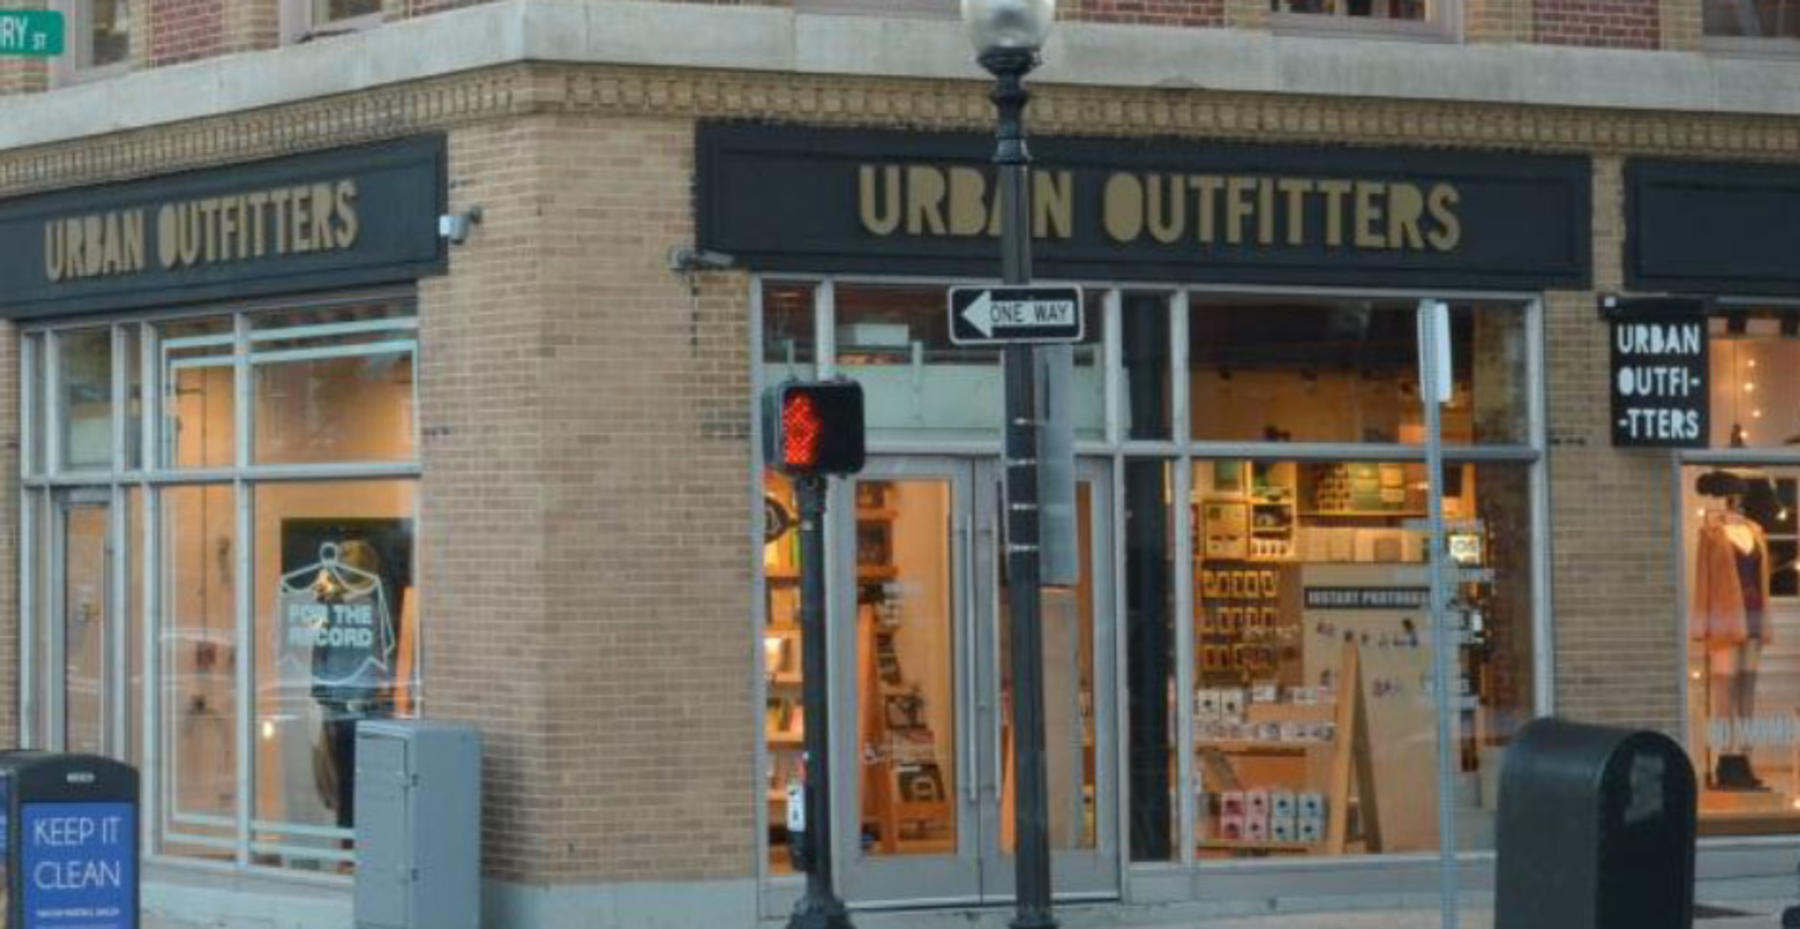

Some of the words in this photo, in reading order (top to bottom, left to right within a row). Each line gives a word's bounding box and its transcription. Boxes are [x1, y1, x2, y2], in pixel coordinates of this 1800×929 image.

[0, 15, 28, 49] RY
[32, 32, 47, 50] ST
[1103, 171, 1462, 252] OUTFITTERS
[45, 207, 146, 281] URBAN
[158, 179, 361, 269] OUTFITTERS
[990, 303, 1025, 323] ONE
[1033, 303, 1069, 322] WAY
[1617, 323, 1700, 355] URBAN
[1617, 366, 1701, 397] OUTFI-
[1618, 407, 1700, 440] -TTERS
[332, 604, 372, 625] THE
[34, 817, 95, 846] KEEP
[102, 816, 121, 845] IT
[34, 860, 121, 889] CLEAN
